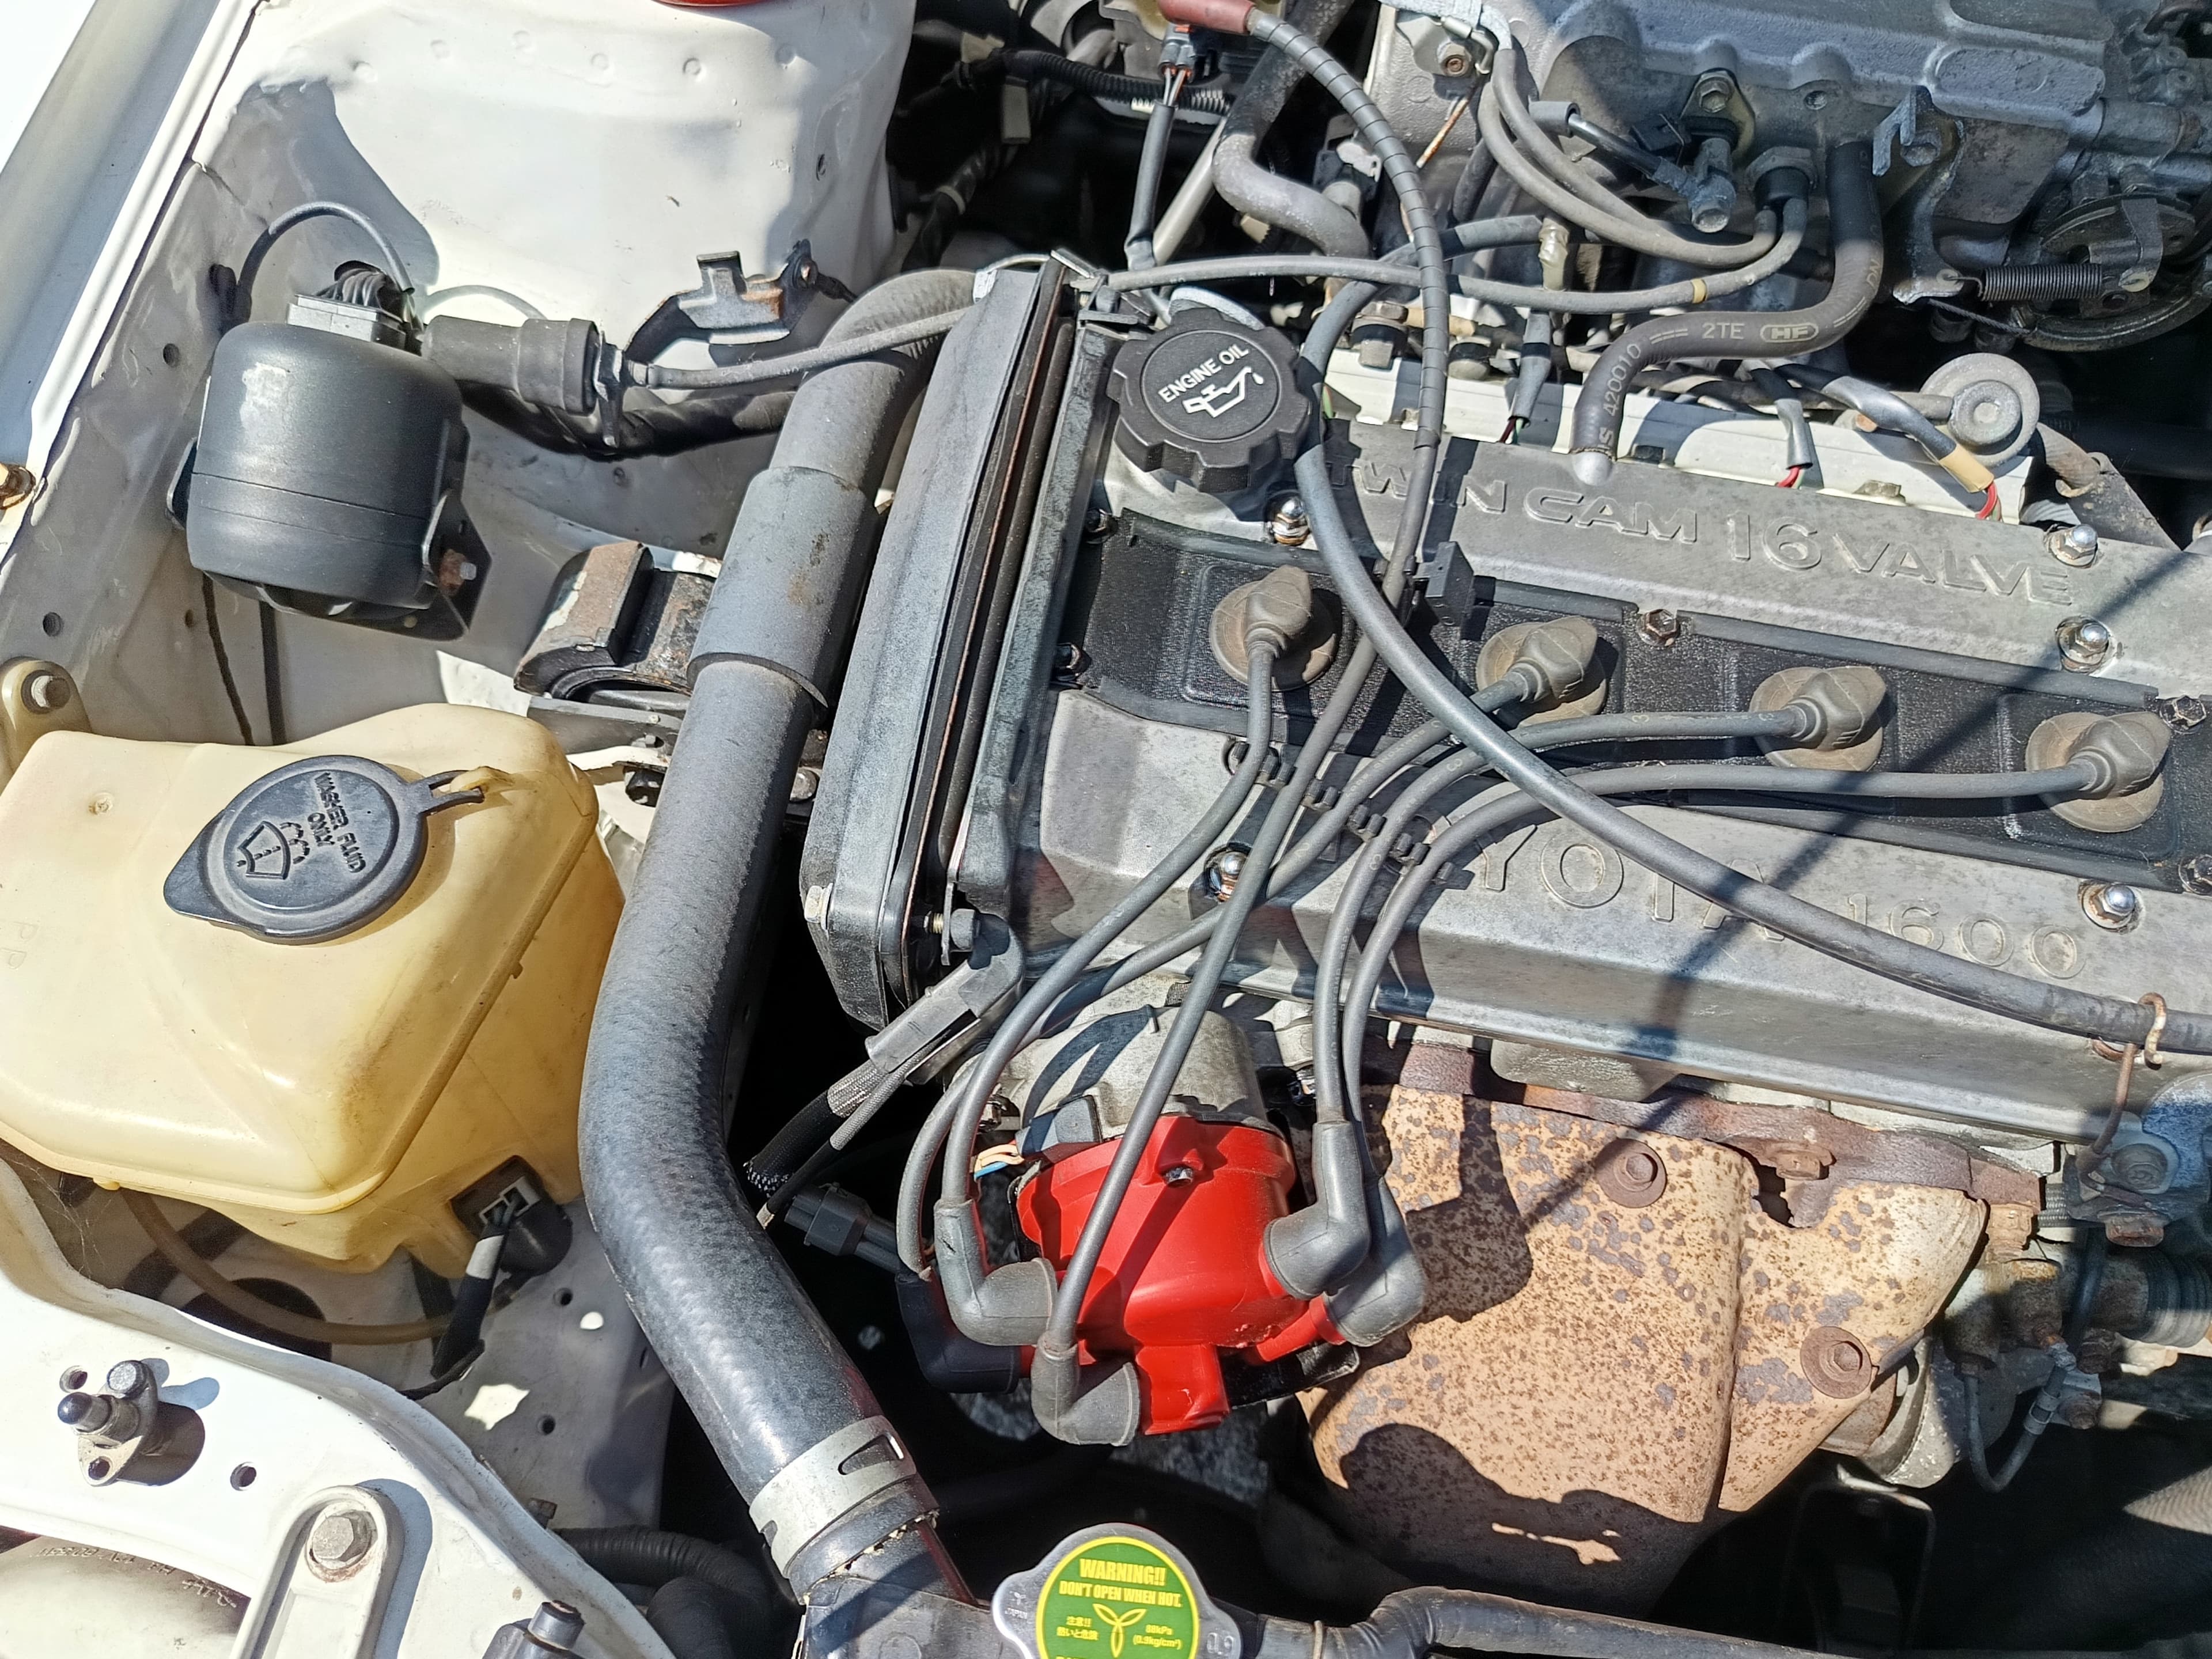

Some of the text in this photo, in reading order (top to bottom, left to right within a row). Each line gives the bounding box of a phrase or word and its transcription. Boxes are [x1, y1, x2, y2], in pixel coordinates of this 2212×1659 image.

[1702, 322, 1745, 340] 2TE
[1158, 344, 1249, 403] ENGINE OIL
[1603, 343, 1642, 416] 420010
[1524, 486, 1698, 544] CAM
[1727, 510, 1821, 571] 16
[1832, 532, 2073, 605] VALVE
[307, 812, 335, 847] ONLY
[315, 772, 366, 873] WASHER FLUID
[1059, 1580, 1182, 1608] DON'T OPEN WHEN HOT.
[1079, 1558, 1167, 1586] WARNING!!
